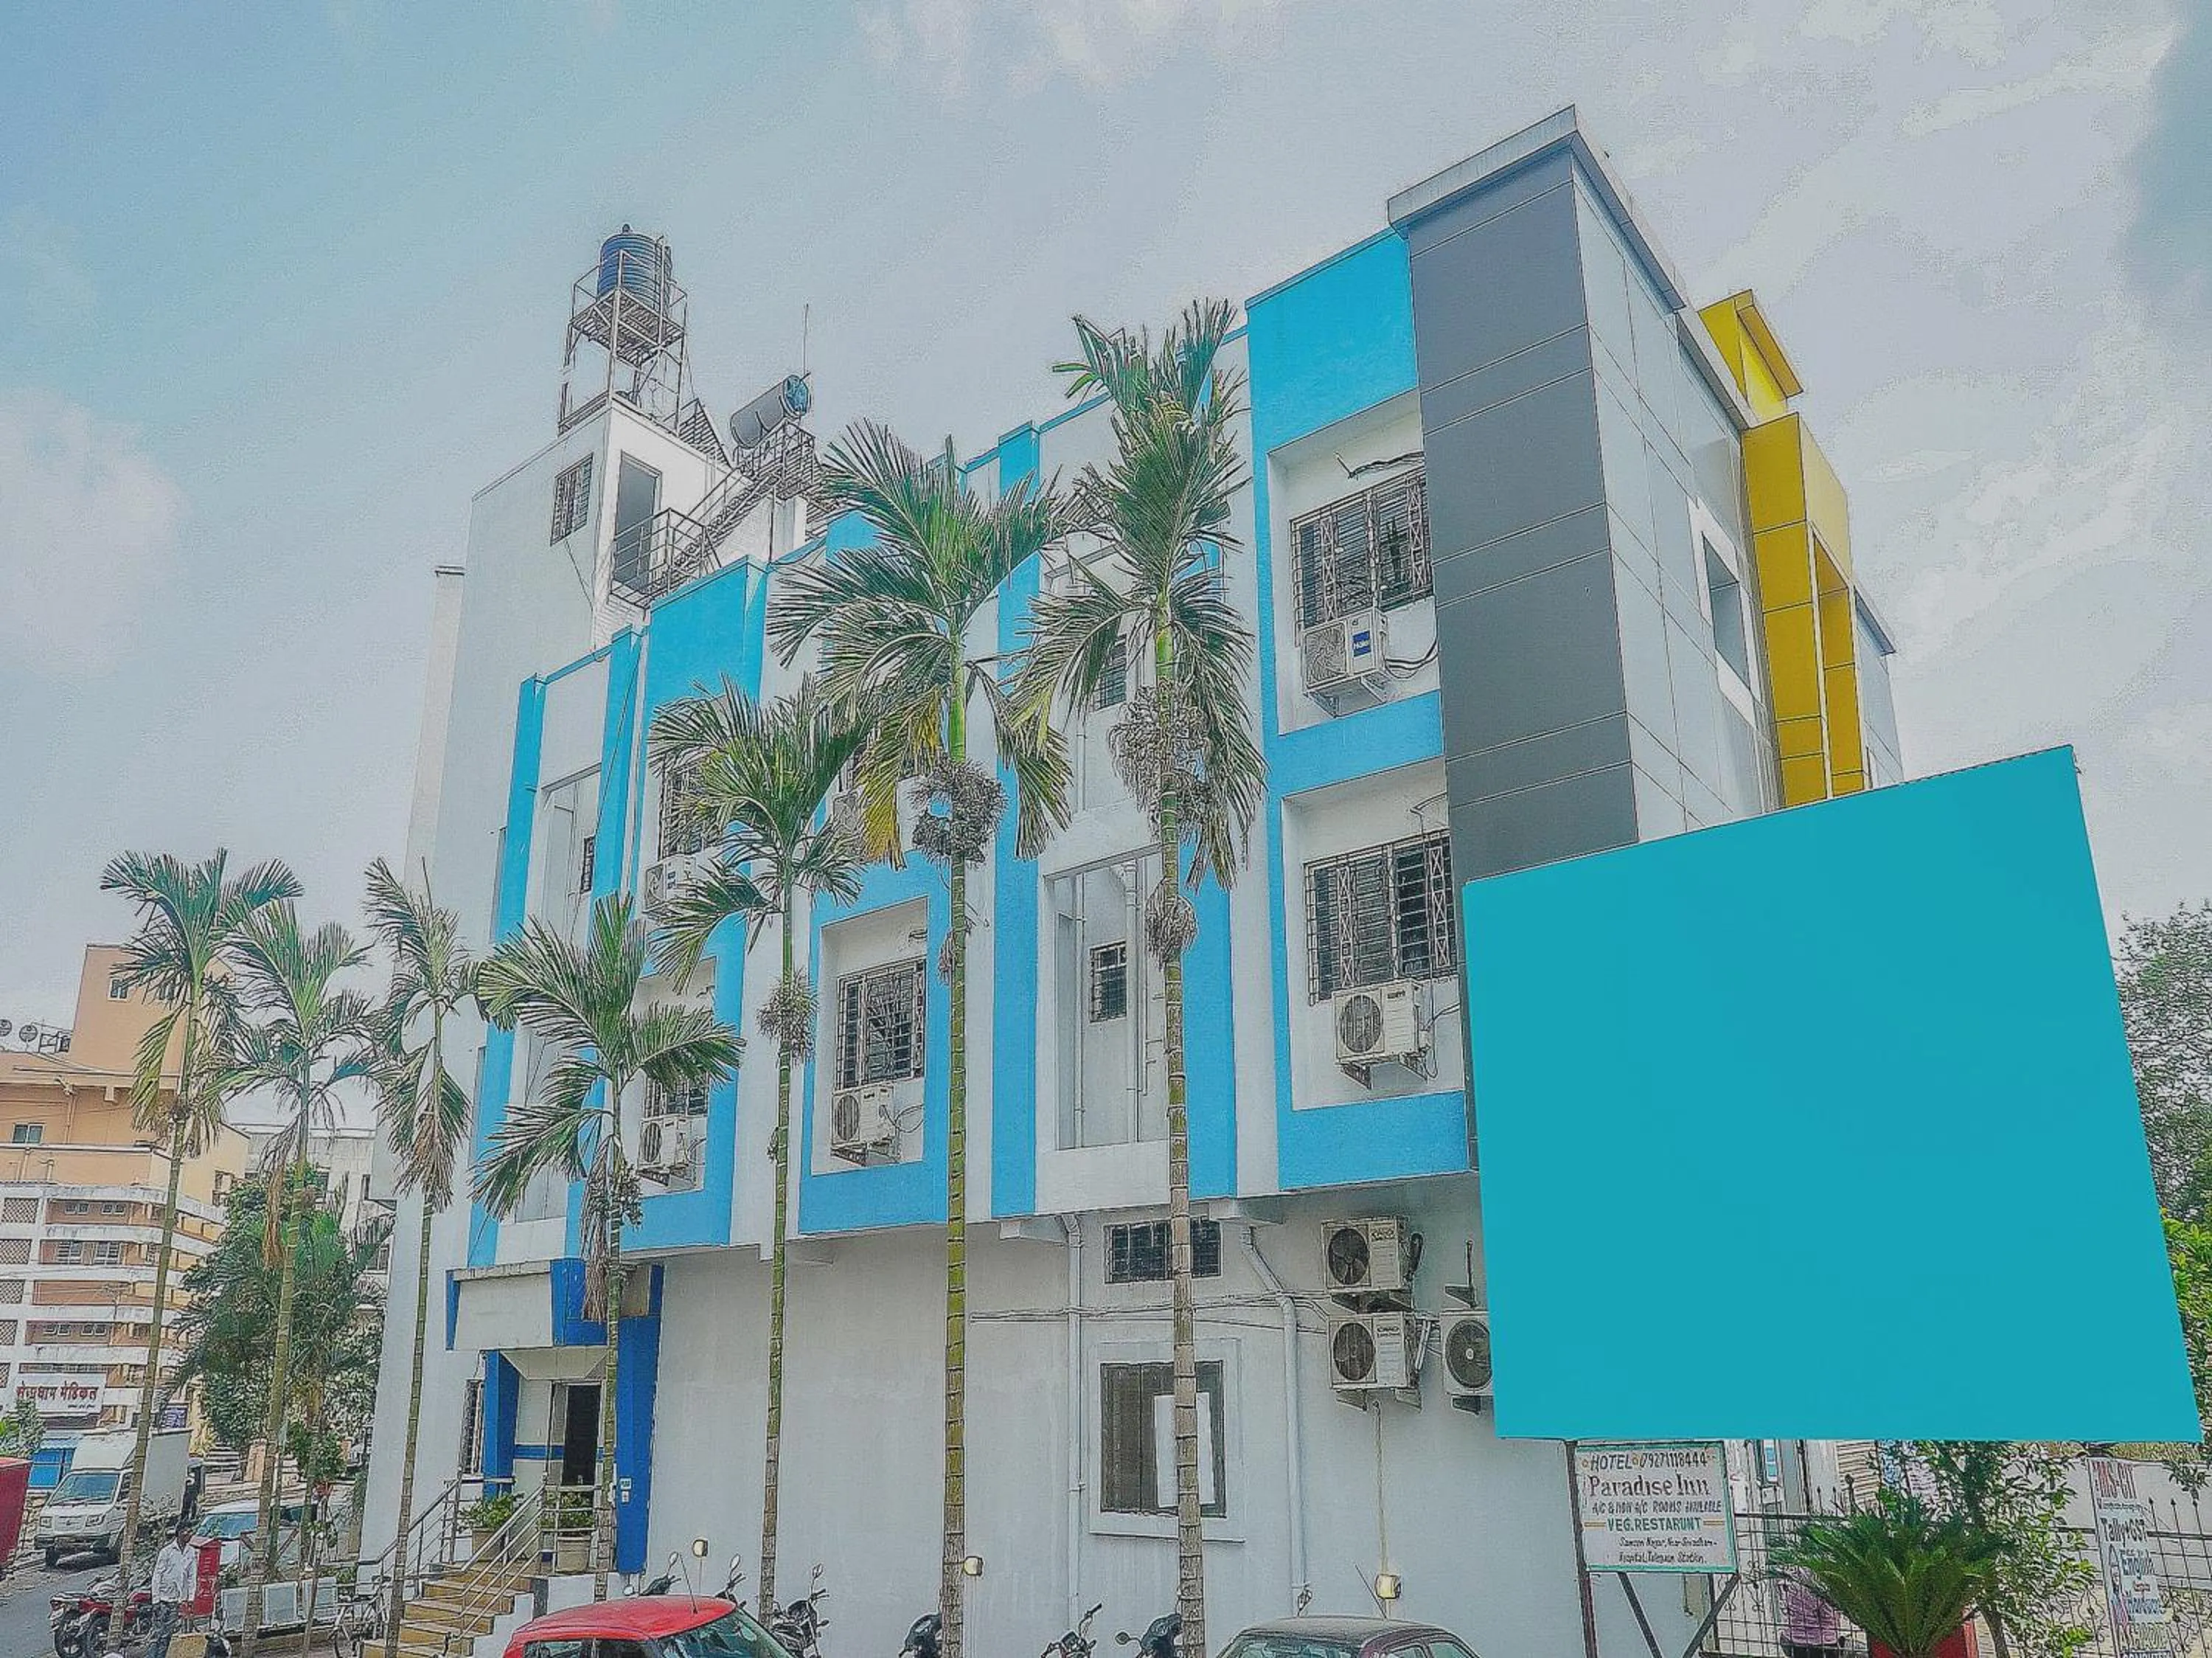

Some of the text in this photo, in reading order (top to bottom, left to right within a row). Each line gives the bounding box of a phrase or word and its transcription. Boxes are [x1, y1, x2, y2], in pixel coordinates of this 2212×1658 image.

[1590, 1453, 1633, 1472] HOTEL
[1587, 1470, 1710, 1496] Paradise Inn
[1652, 1499, 1682, 1513] ROOMS
